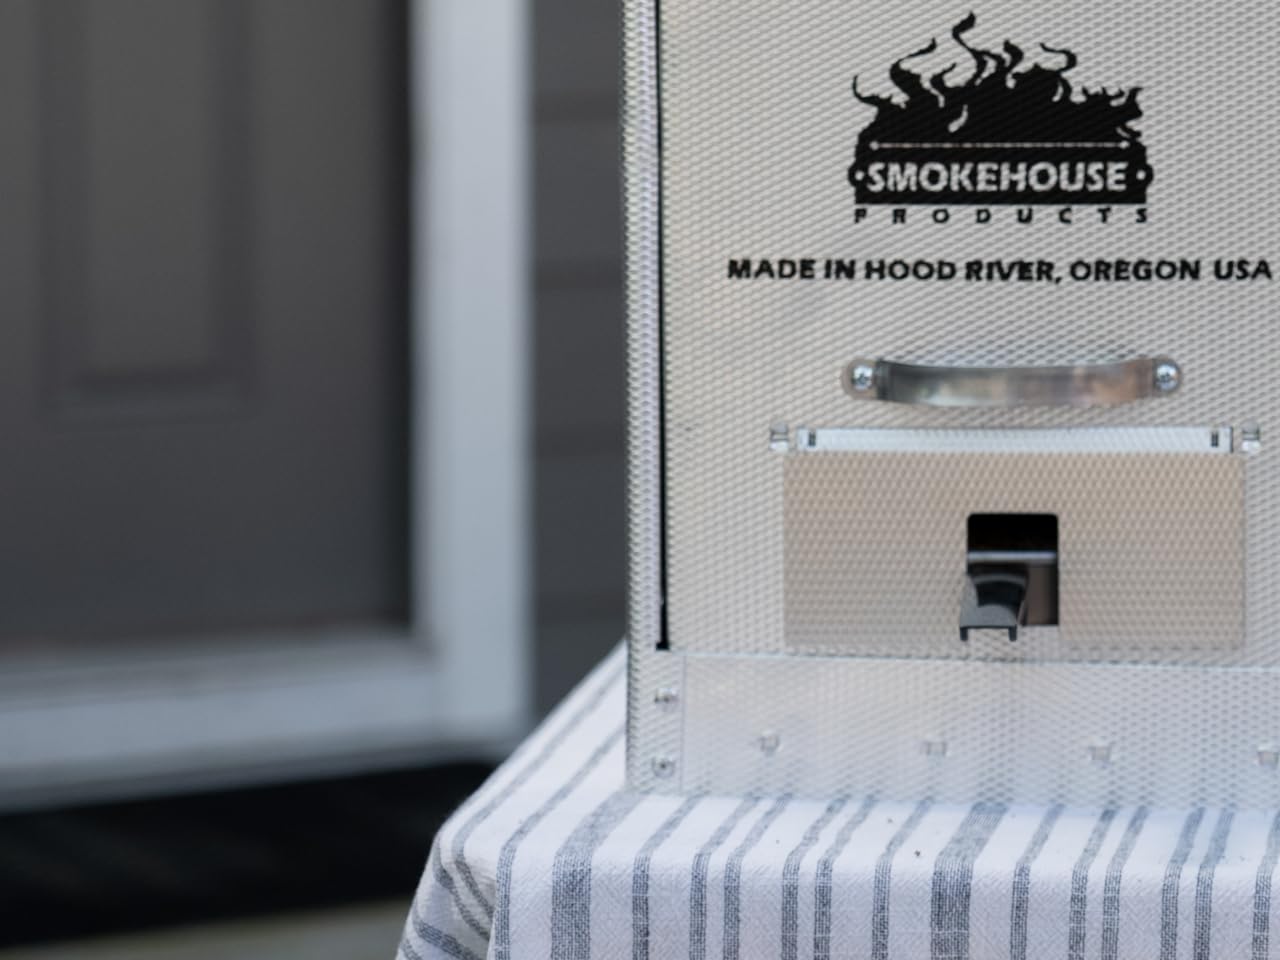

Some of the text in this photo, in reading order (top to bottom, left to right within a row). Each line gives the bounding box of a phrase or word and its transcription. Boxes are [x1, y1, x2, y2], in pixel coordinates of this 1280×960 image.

[866, 160, 1128, 193] SMOKEHOUSE
[853, 207, 1148, 225] PRODUCTS
[727, 258, 1273, 285] MADE IN HOOD RIVER, OREGON USA
